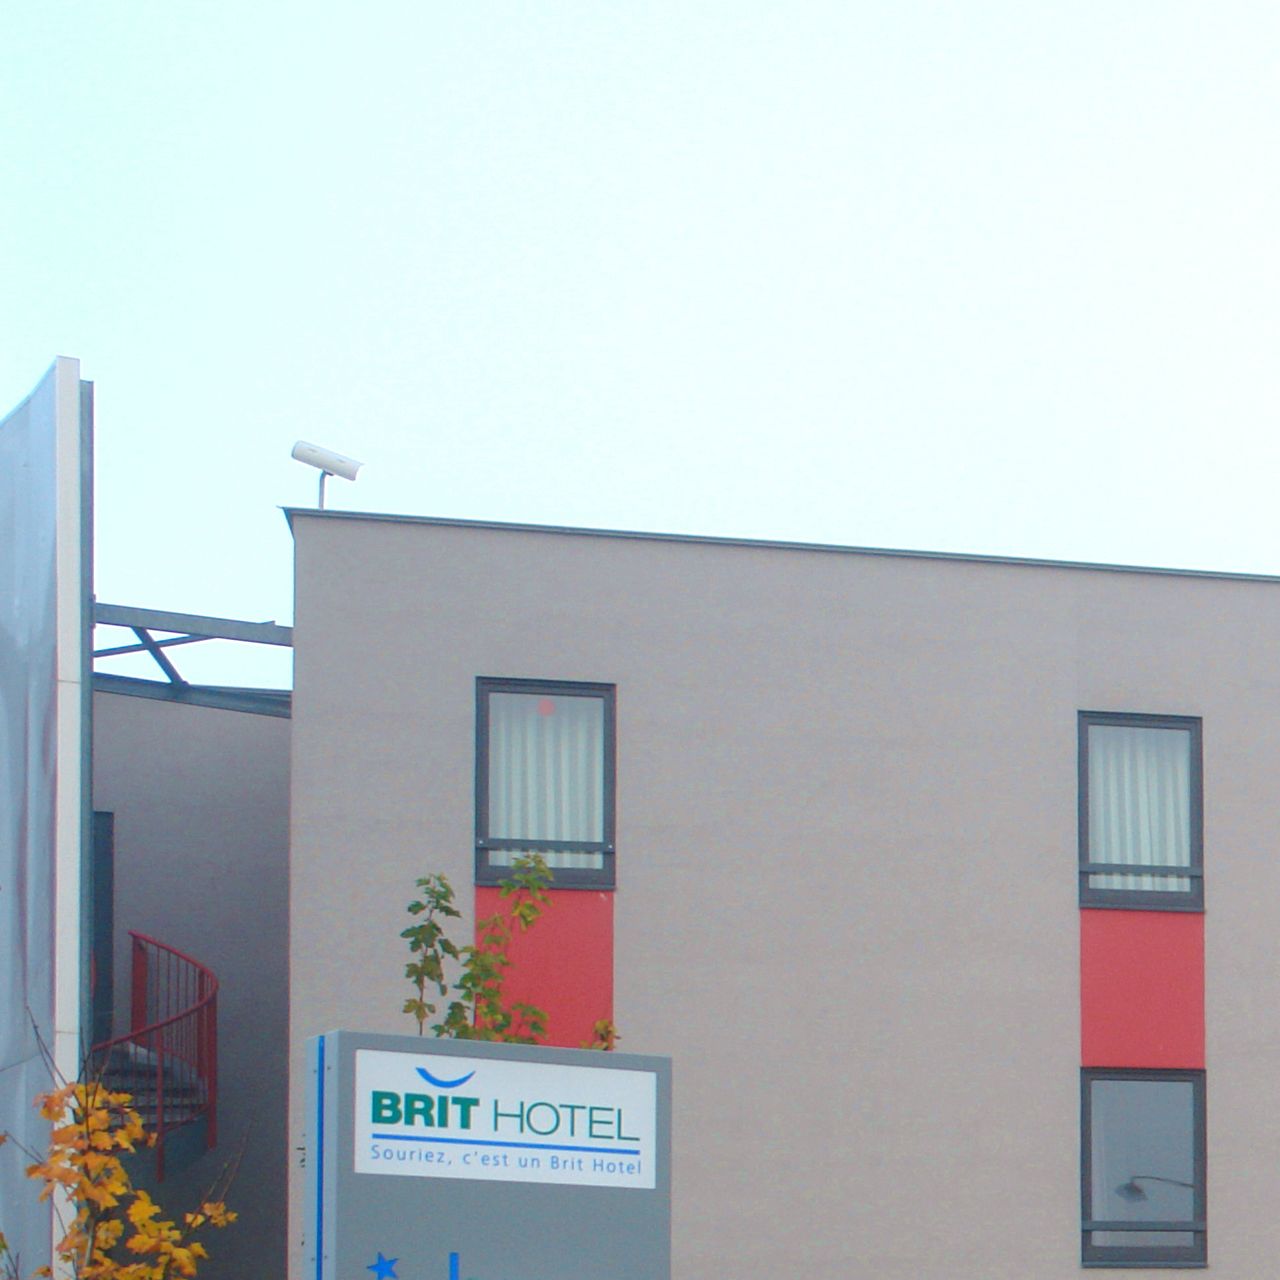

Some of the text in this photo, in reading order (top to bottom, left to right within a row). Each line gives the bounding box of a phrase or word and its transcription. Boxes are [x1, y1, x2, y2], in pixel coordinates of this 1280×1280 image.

[371, 1090, 641, 1142] BRIT HOTEL
[370, 1144, 642, 1175] Souriez, c'est un Brit Hotel
